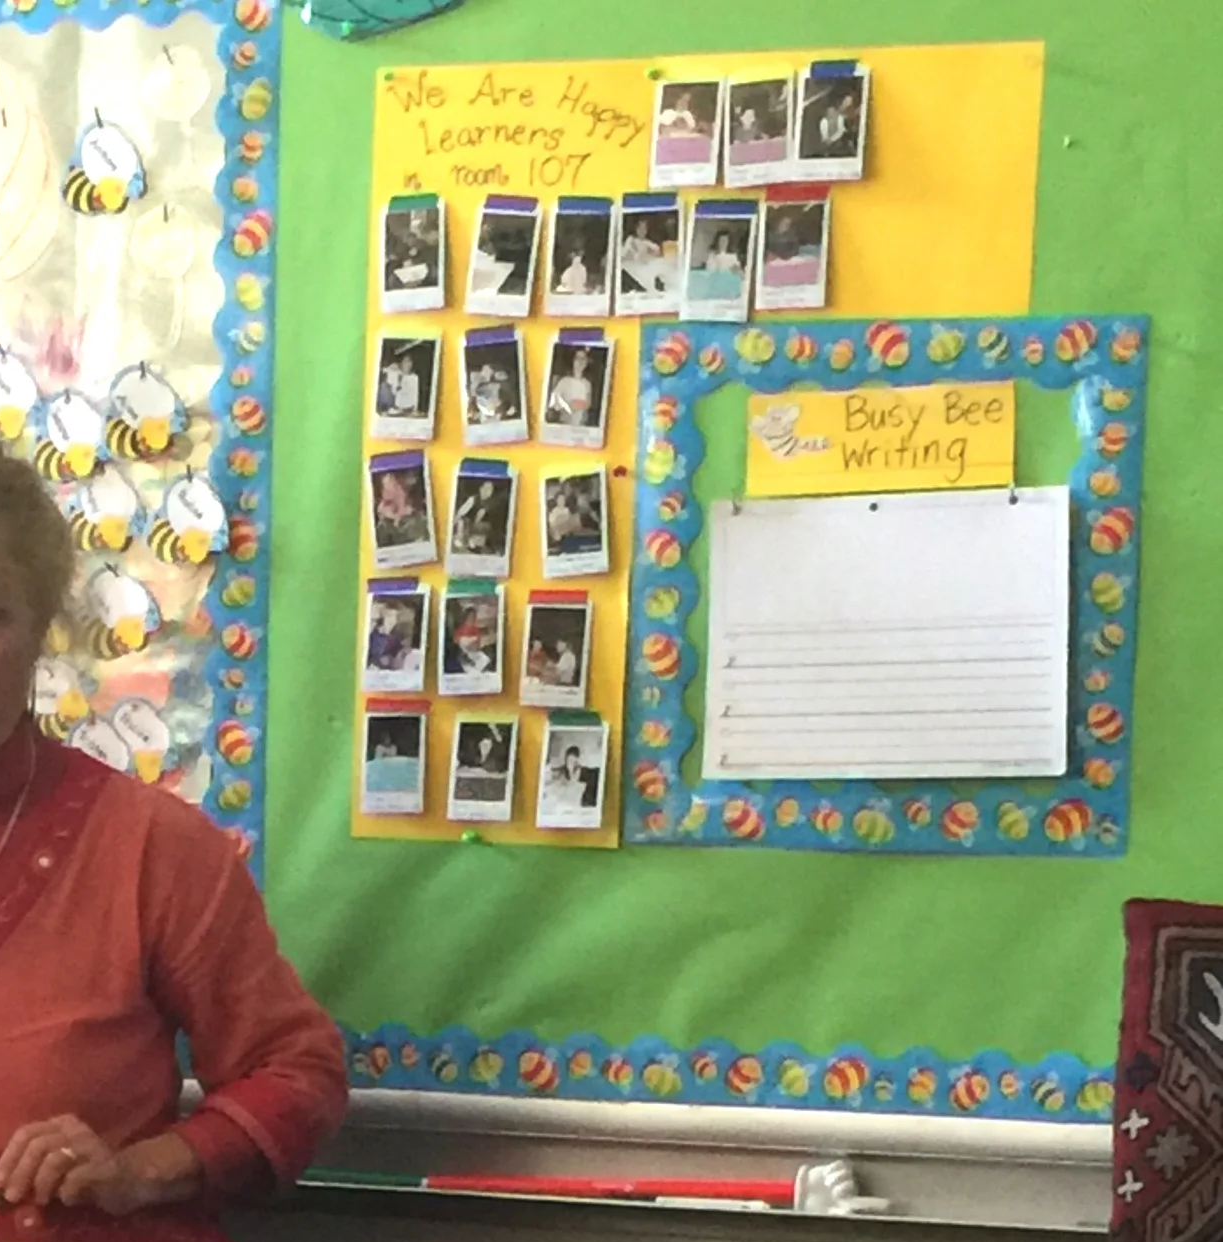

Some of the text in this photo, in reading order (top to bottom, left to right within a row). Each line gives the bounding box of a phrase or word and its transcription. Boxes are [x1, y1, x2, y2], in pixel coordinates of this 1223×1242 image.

[386, 70, 646, 148] We Are Happy
[418, 119, 565, 155] Learners
[404, 152, 592, 190] in room 107
[844, 390, 1005, 443] Busy Bee
[840, 435, 969, 484] Writing
